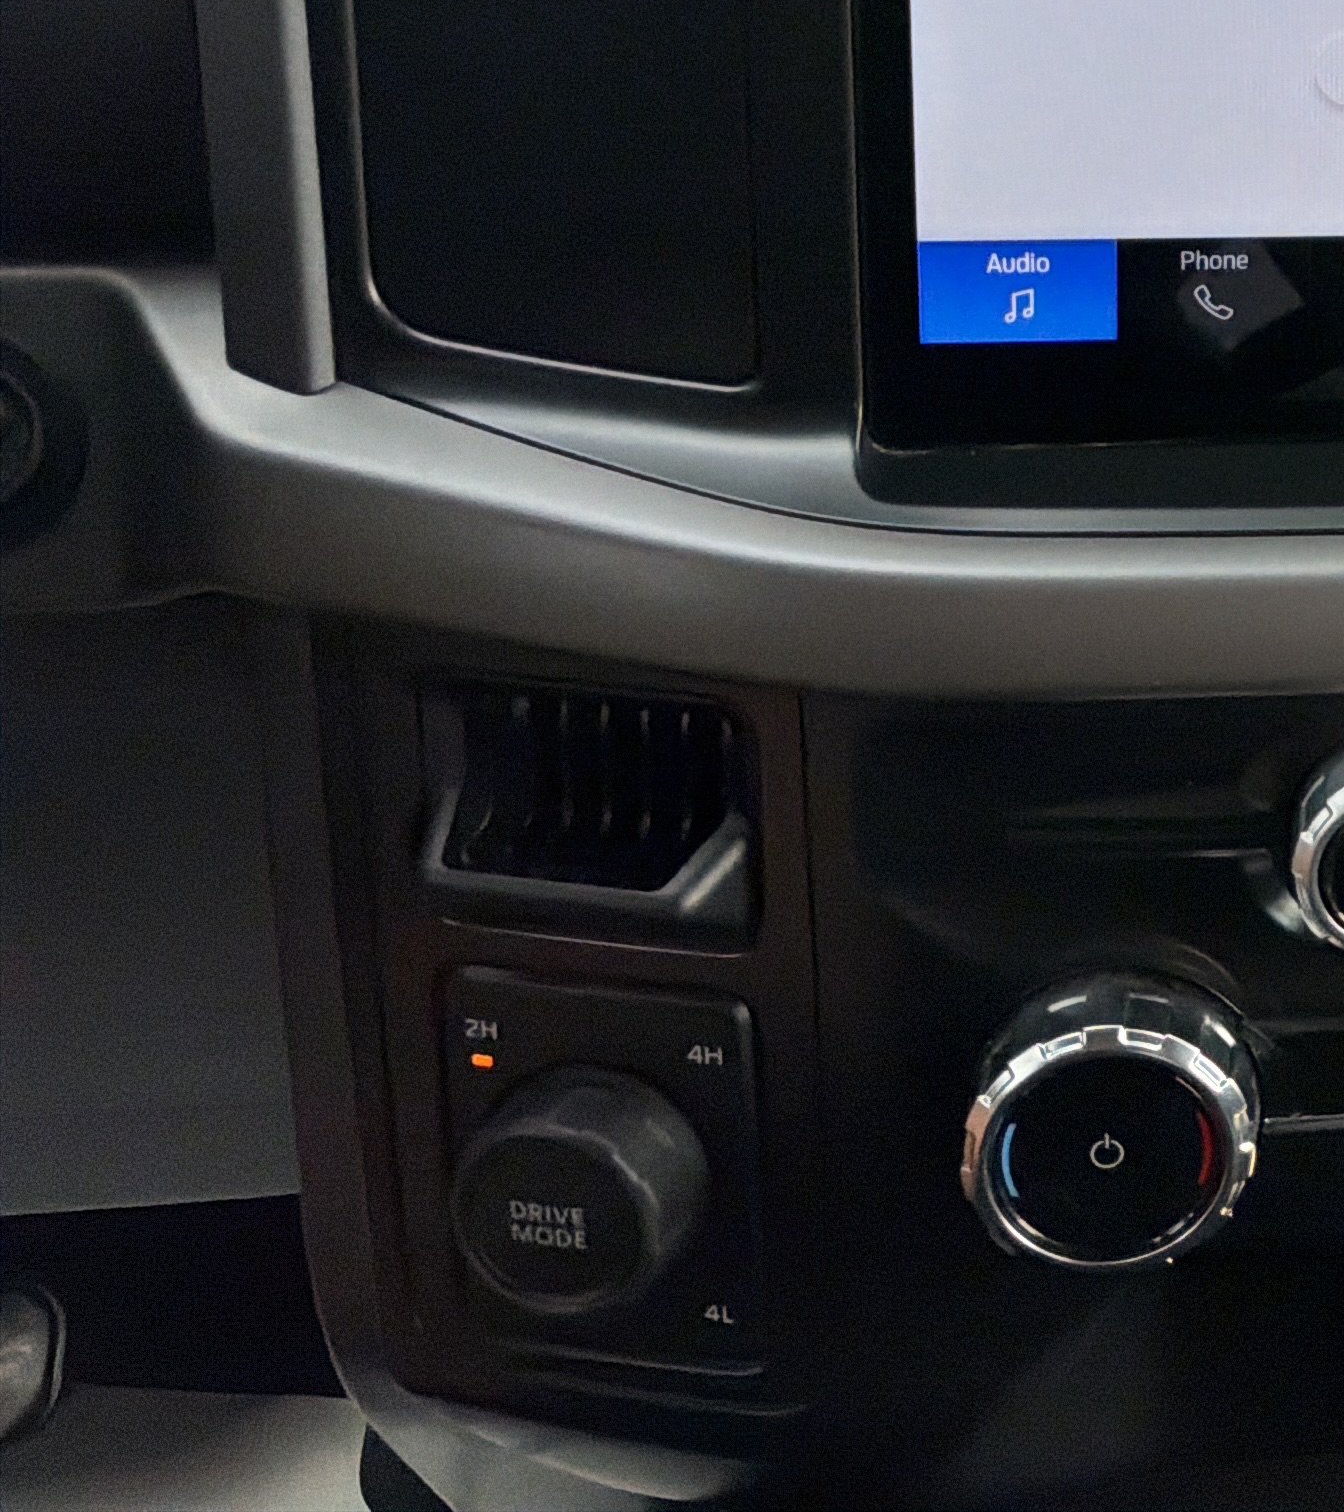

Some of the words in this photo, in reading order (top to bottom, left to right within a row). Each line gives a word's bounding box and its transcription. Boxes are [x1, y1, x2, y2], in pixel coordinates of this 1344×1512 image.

[985, 252, 1051, 276] Audio
[1180, 249, 1249, 272] Phone
[464, 1018, 498, 1041] 2H
[686, 1045, 724, 1067] 4H
[509, 1200, 585, 1228] DRIVE
[510, 1223, 588, 1251] MODE
[703, 1304, 735, 1324] 4L
